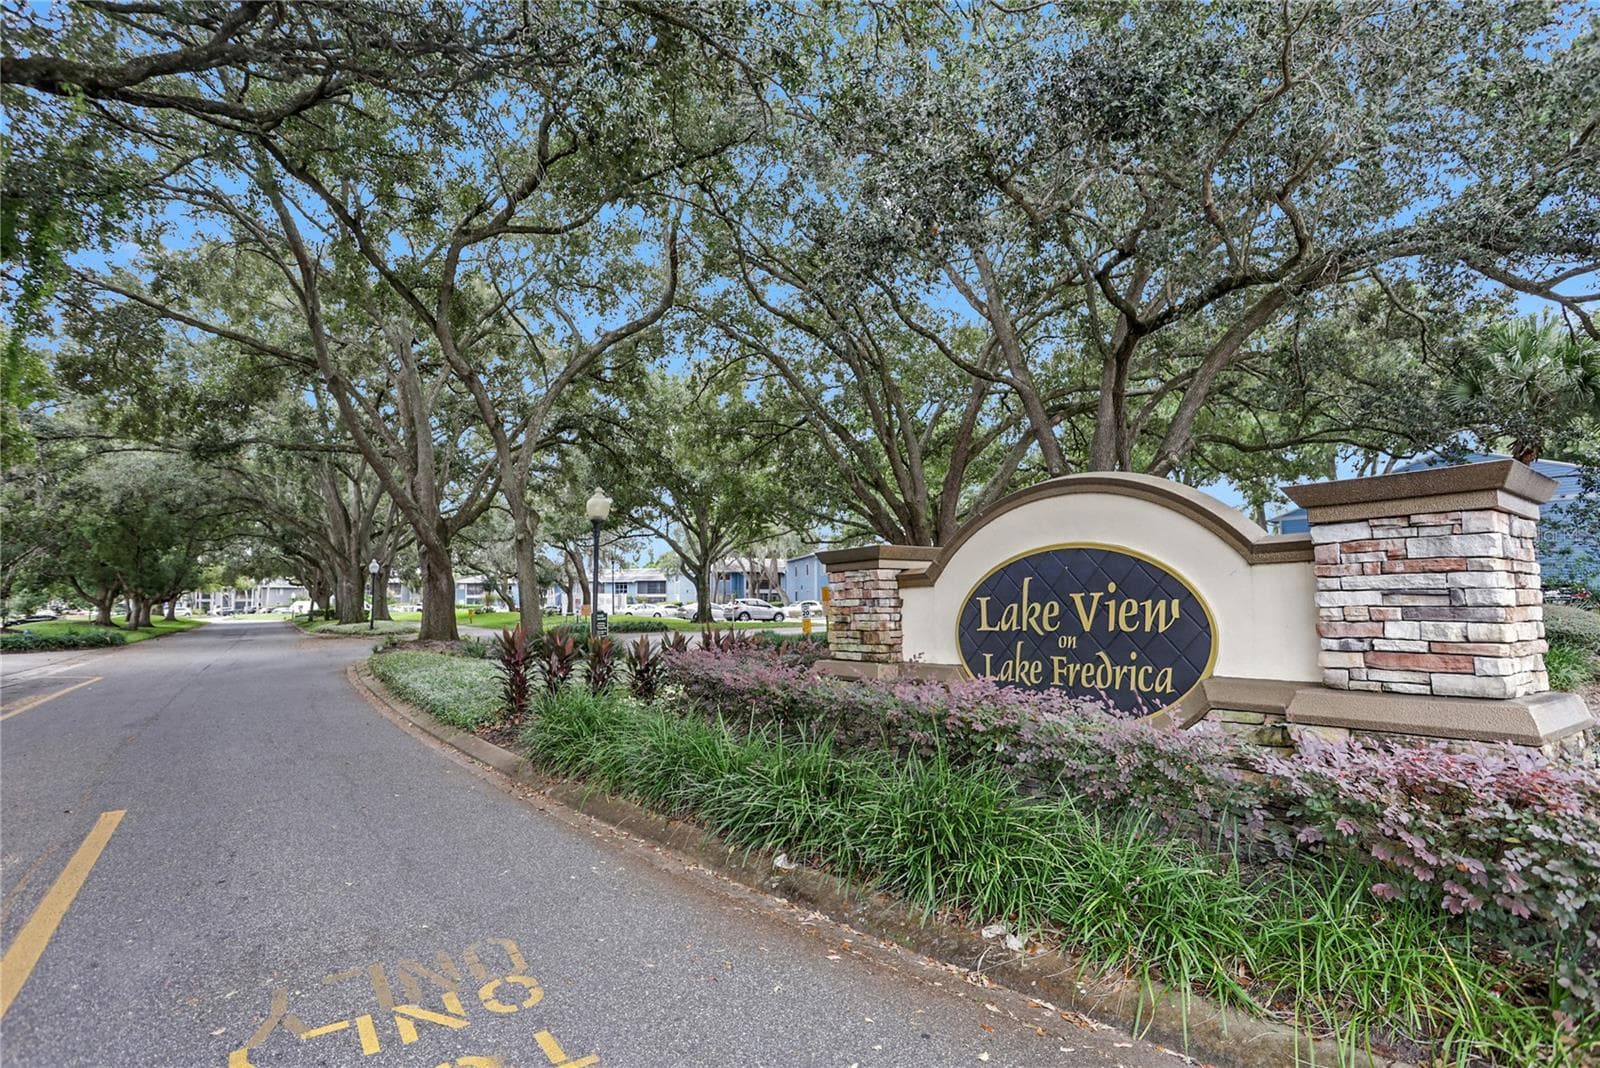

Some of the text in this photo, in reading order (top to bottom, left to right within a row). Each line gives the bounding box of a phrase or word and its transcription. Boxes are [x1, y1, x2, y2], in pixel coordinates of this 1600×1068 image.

[976, 577, 1180, 635] Lake View
[982, 640, 1175, 694] Lake Fredrica
[1058, 634, 1077, 649] on
